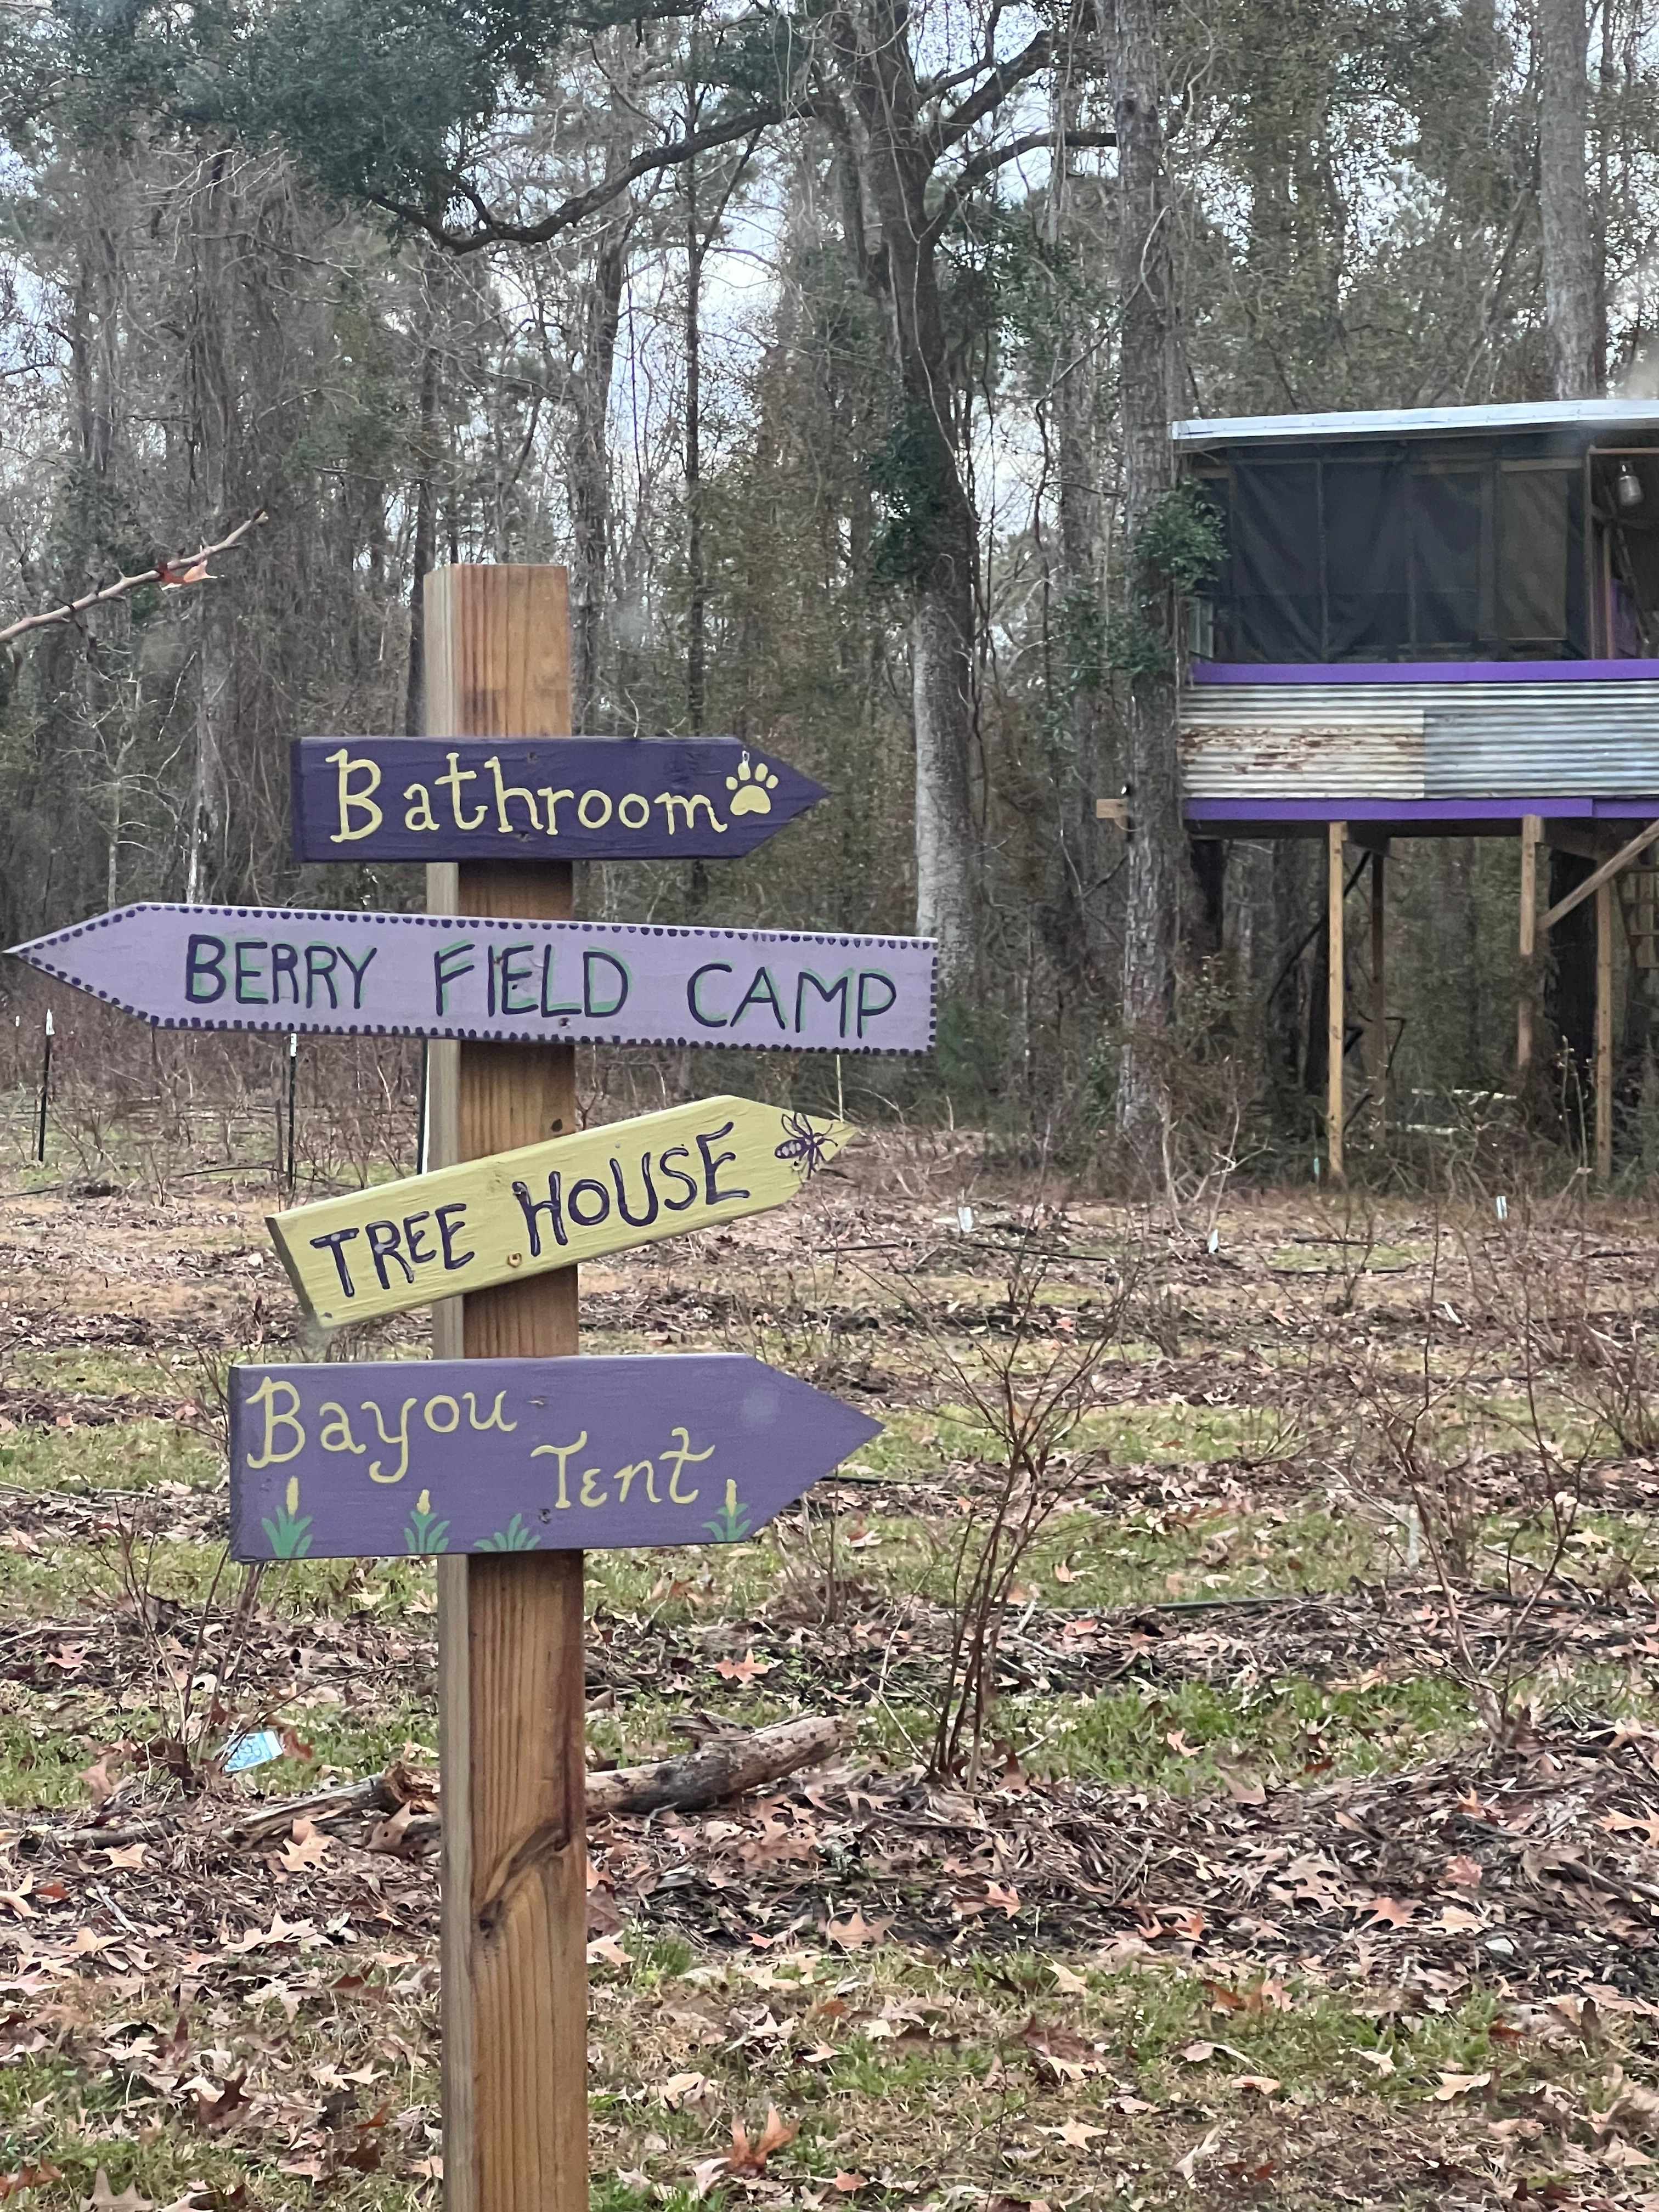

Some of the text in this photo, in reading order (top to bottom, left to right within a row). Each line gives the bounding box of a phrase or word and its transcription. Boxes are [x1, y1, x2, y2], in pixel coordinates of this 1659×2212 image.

[325, 748, 728, 843] Bathroom
[185, 934, 898, 1039] BERRY FIELD CAMP
[310, 1121, 751, 1298] TREE HOUSE
[246, 1376, 517, 1485] Bayou
[531, 1426, 715, 1510] Tent
